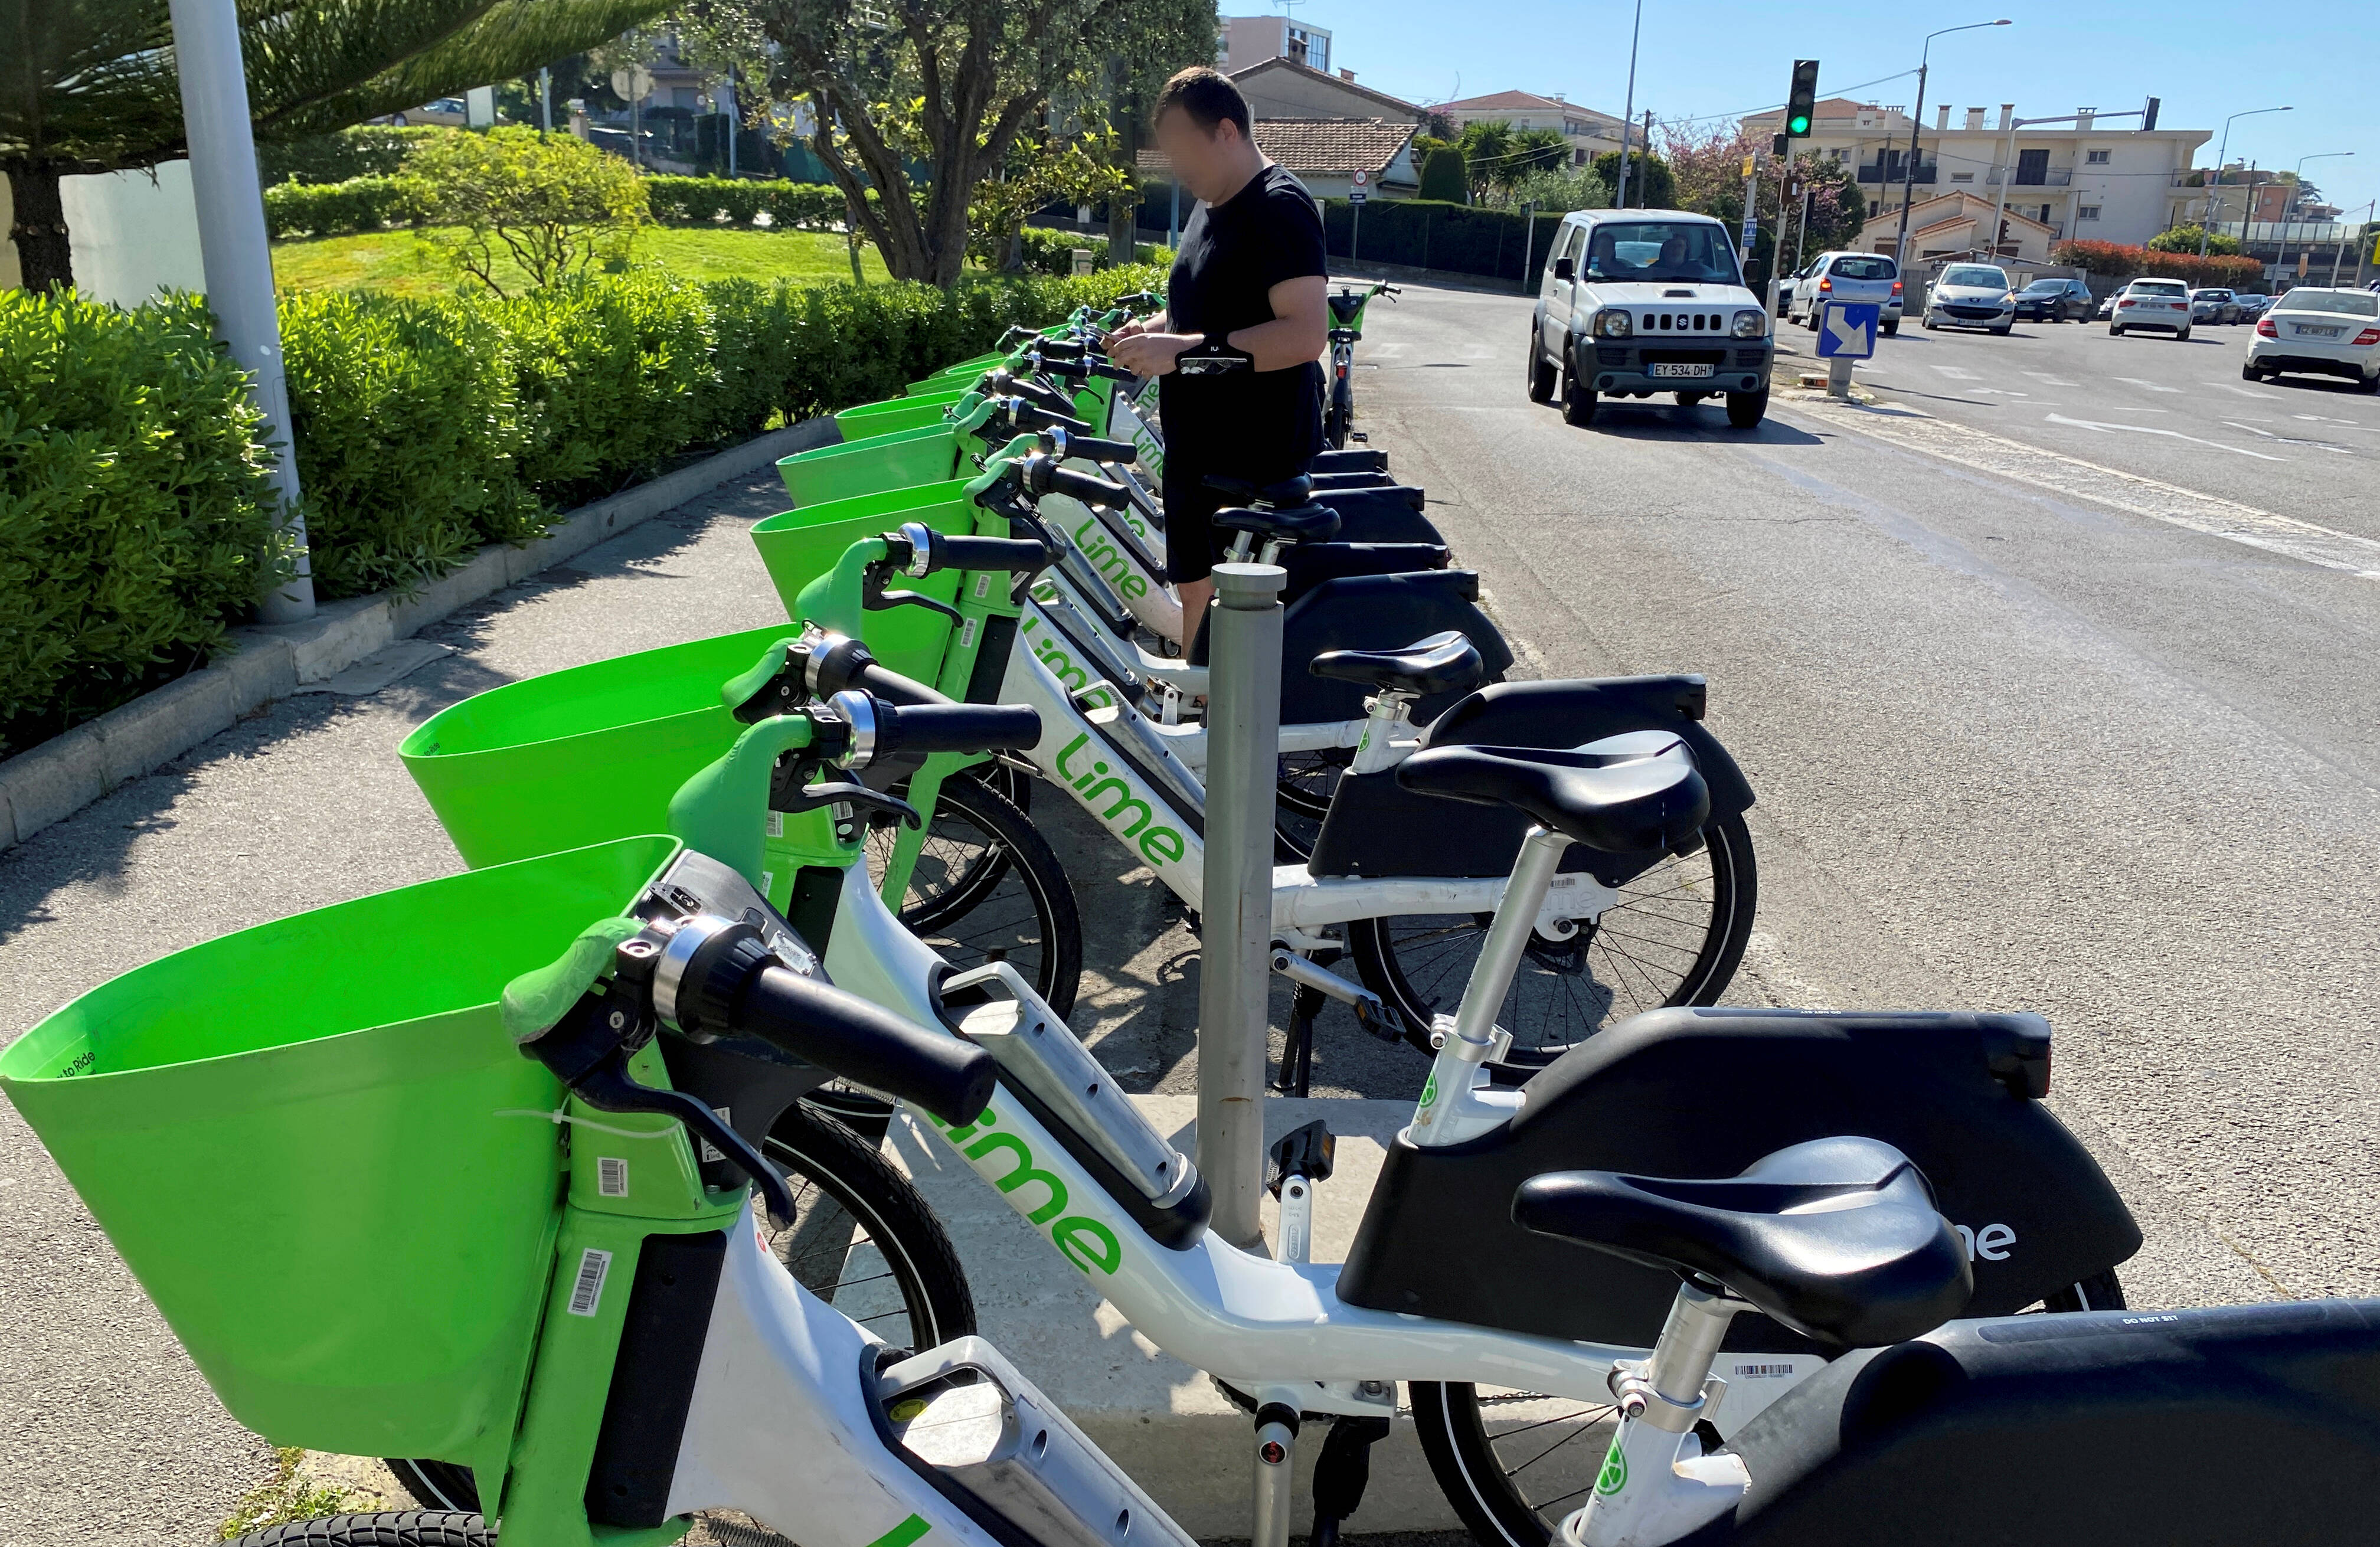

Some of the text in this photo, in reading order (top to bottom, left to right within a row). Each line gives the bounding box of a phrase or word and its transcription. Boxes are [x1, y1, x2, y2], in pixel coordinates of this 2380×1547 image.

[1074, 517, 1148, 601] Lime
[1056, 732, 1185, 867] Lime
[73, 1052, 96, 1072] Ride
